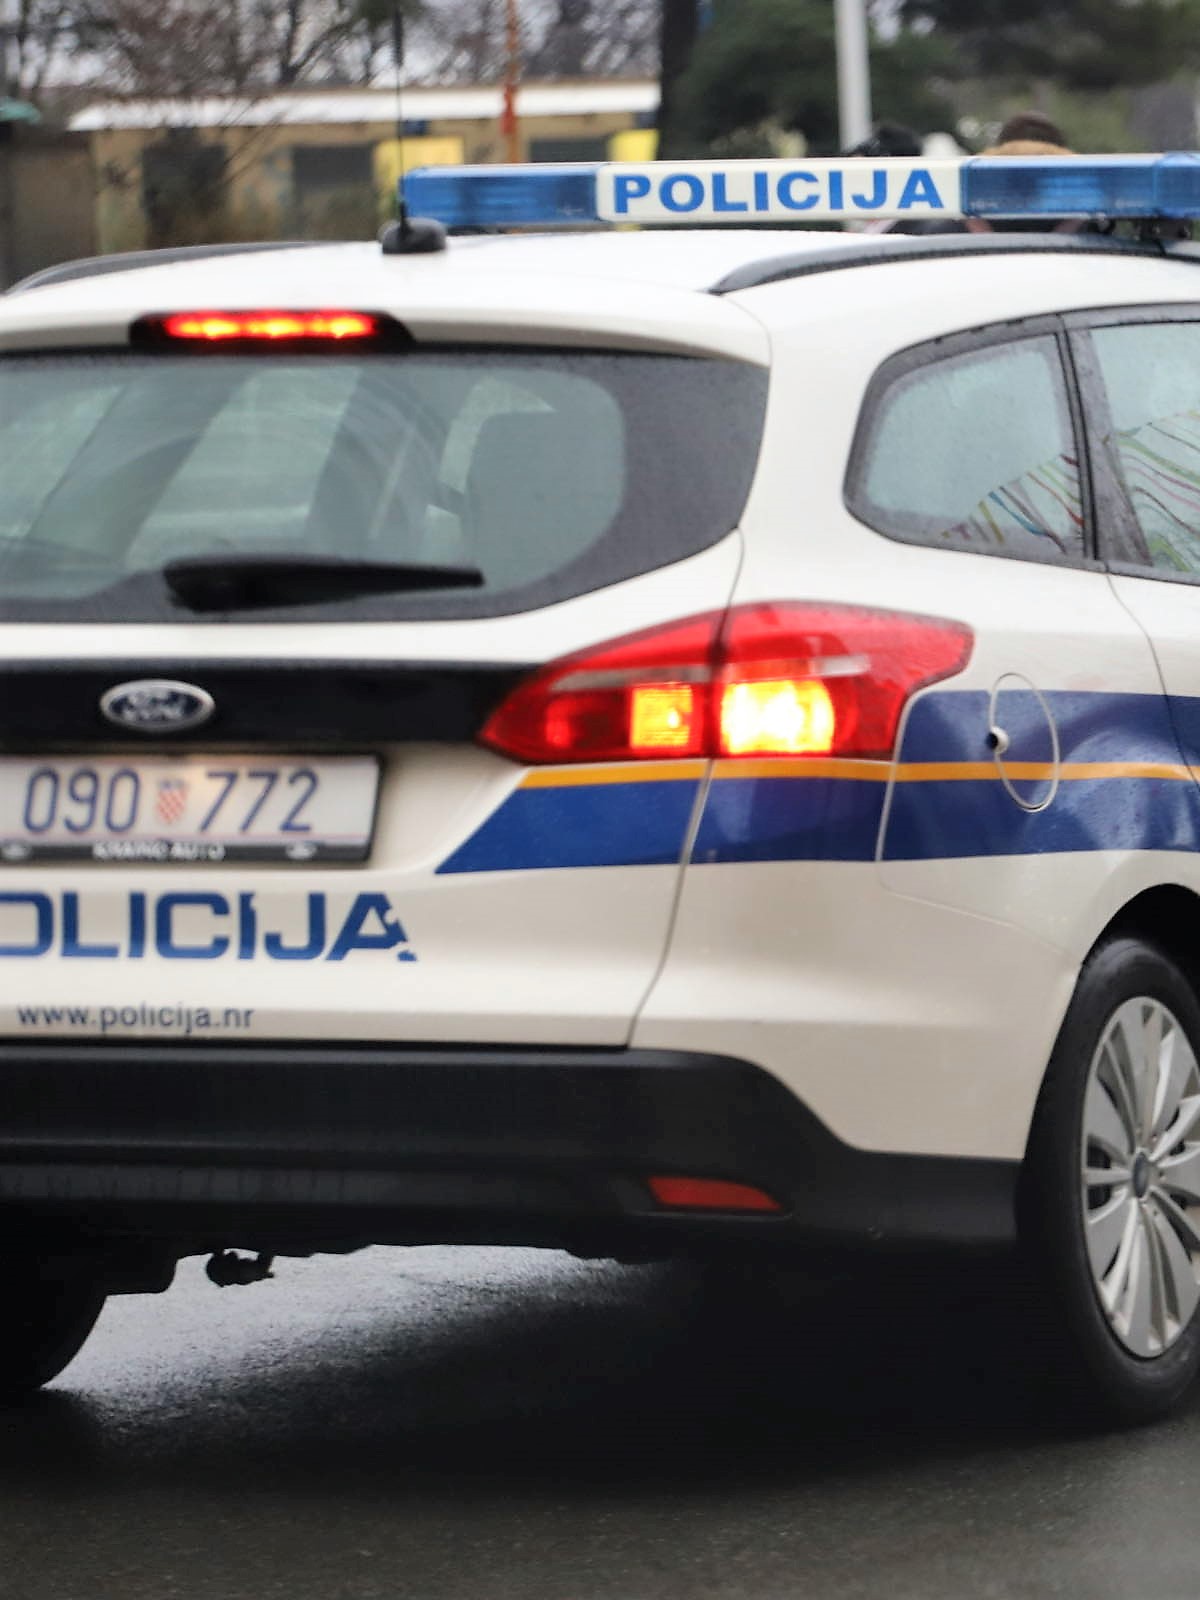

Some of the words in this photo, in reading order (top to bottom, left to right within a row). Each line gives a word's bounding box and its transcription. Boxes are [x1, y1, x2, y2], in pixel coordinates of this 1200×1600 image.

[613, 169, 944, 214] POLICIJA
[24, 766, 141, 833] 090
[200, 770, 319, 833] 772
